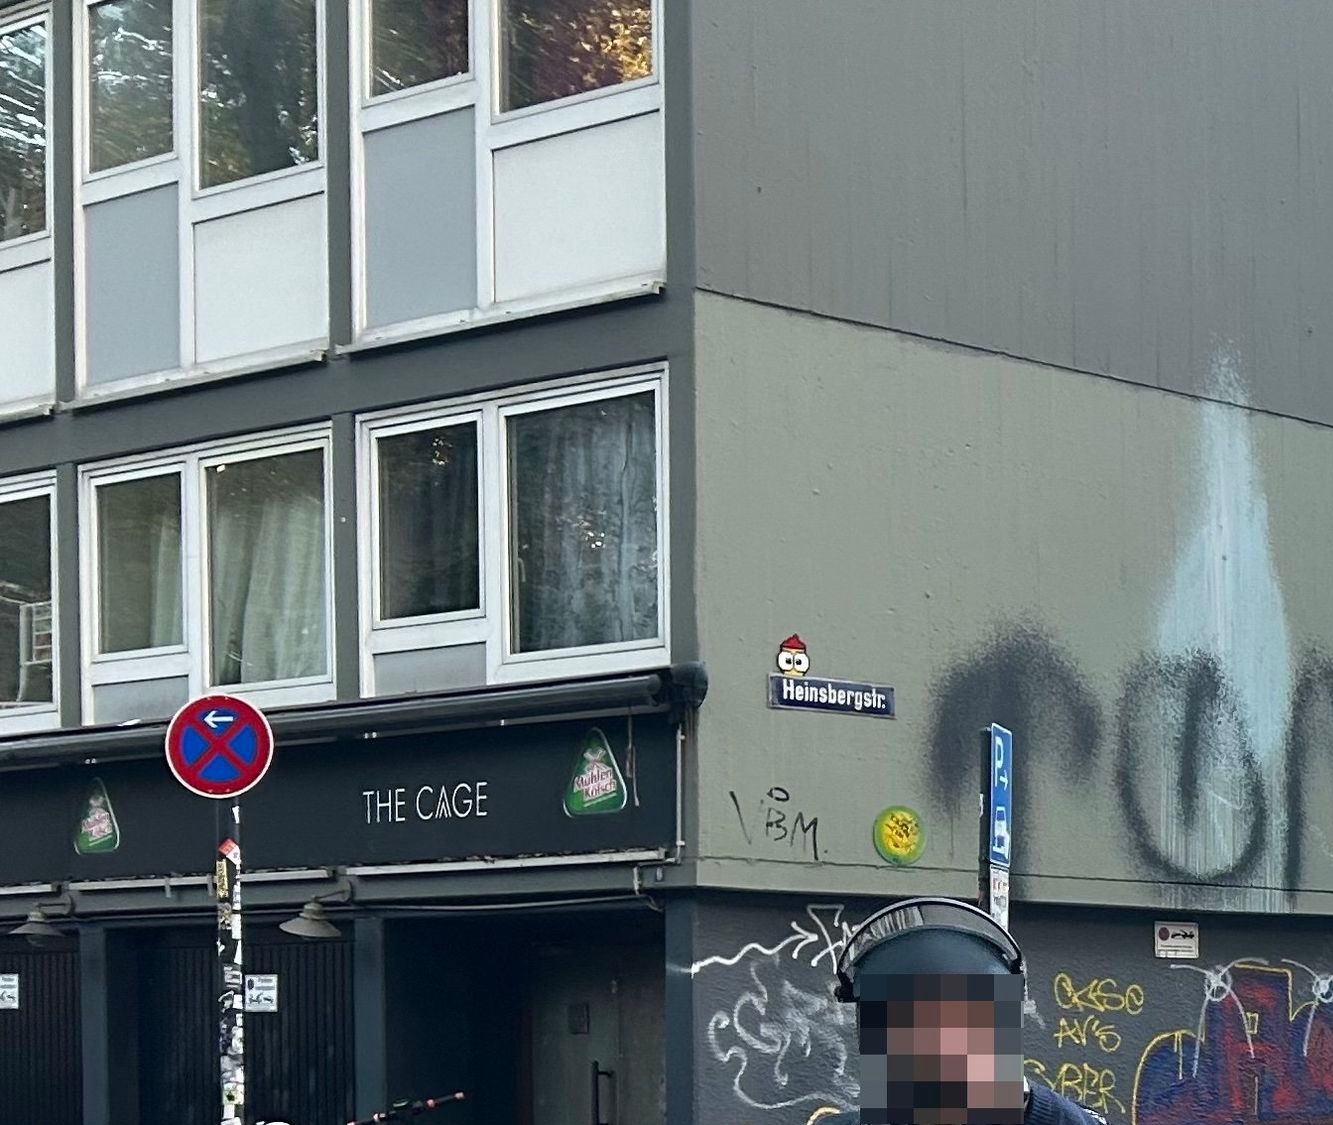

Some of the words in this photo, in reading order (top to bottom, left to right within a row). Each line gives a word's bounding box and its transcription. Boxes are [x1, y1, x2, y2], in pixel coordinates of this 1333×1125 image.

[781, 677, 887, 711] Heinsbergstr.
[362, 787, 406, 825] THE
[415, 781, 488, 821] CAGE
